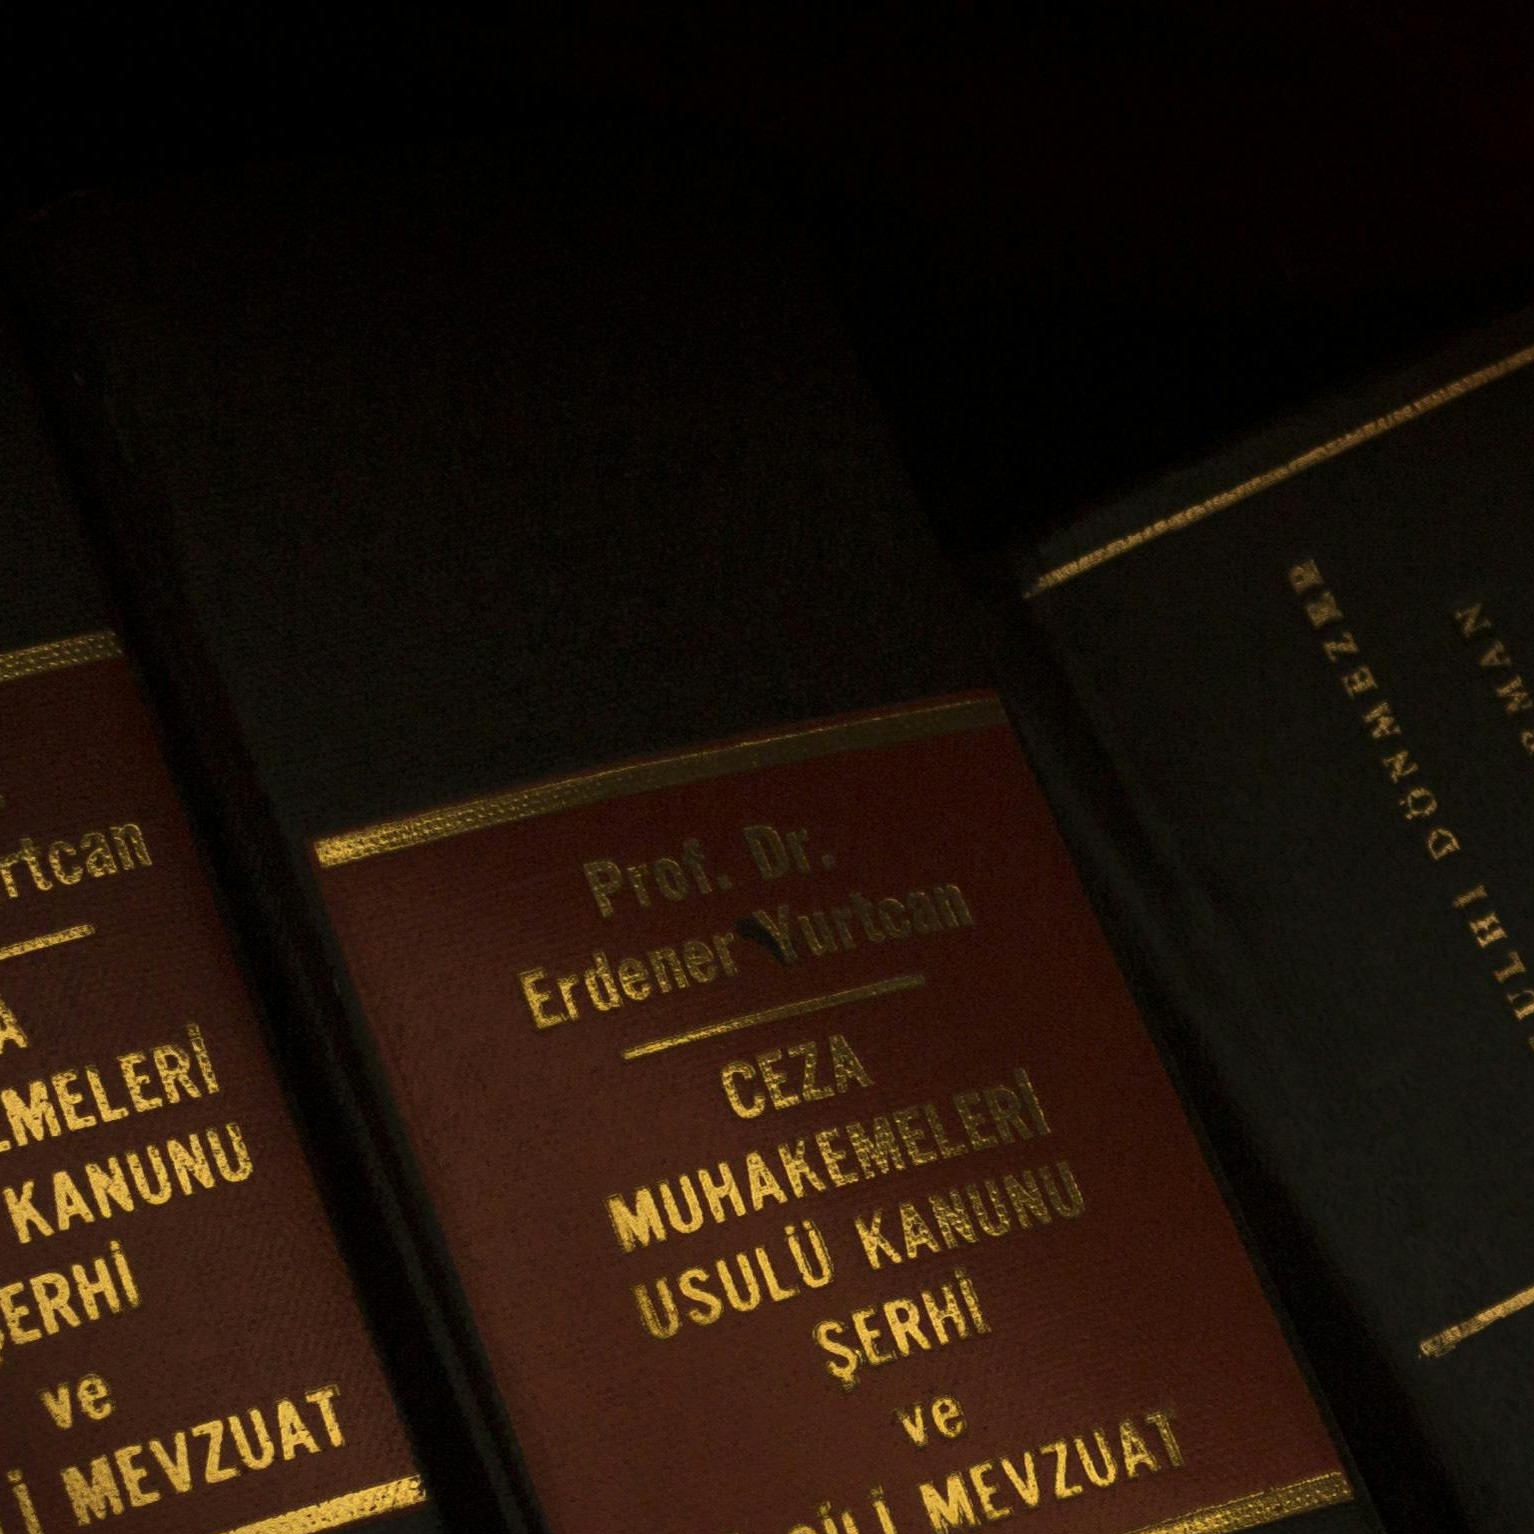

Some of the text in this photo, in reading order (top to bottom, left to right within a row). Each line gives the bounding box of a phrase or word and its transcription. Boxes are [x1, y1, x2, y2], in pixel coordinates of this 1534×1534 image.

[583, 824, 838, 919] Prof. Dr.
[517, 880, 975, 1033] Erdener Yurtcan
[0, 1022, 220, 1150] MELERİ
[719, 1033, 874, 1121] CEZA
[2, 1121, 254, 1244] KANUNU
[605, 1066, 1053, 1254] MUHAKEMELERİ
[0, 1239, 141, 1362] ERHİ
[631, 1158, 1089, 1341] USULÜ KANUNU
[811, 1266, 992, 1393] ŞERHİ
[39, 1374, 114, 1430] ve
[60, 1384, 345, 1526] MEVZUAT
[894, 1392, 967, 1446] ve
